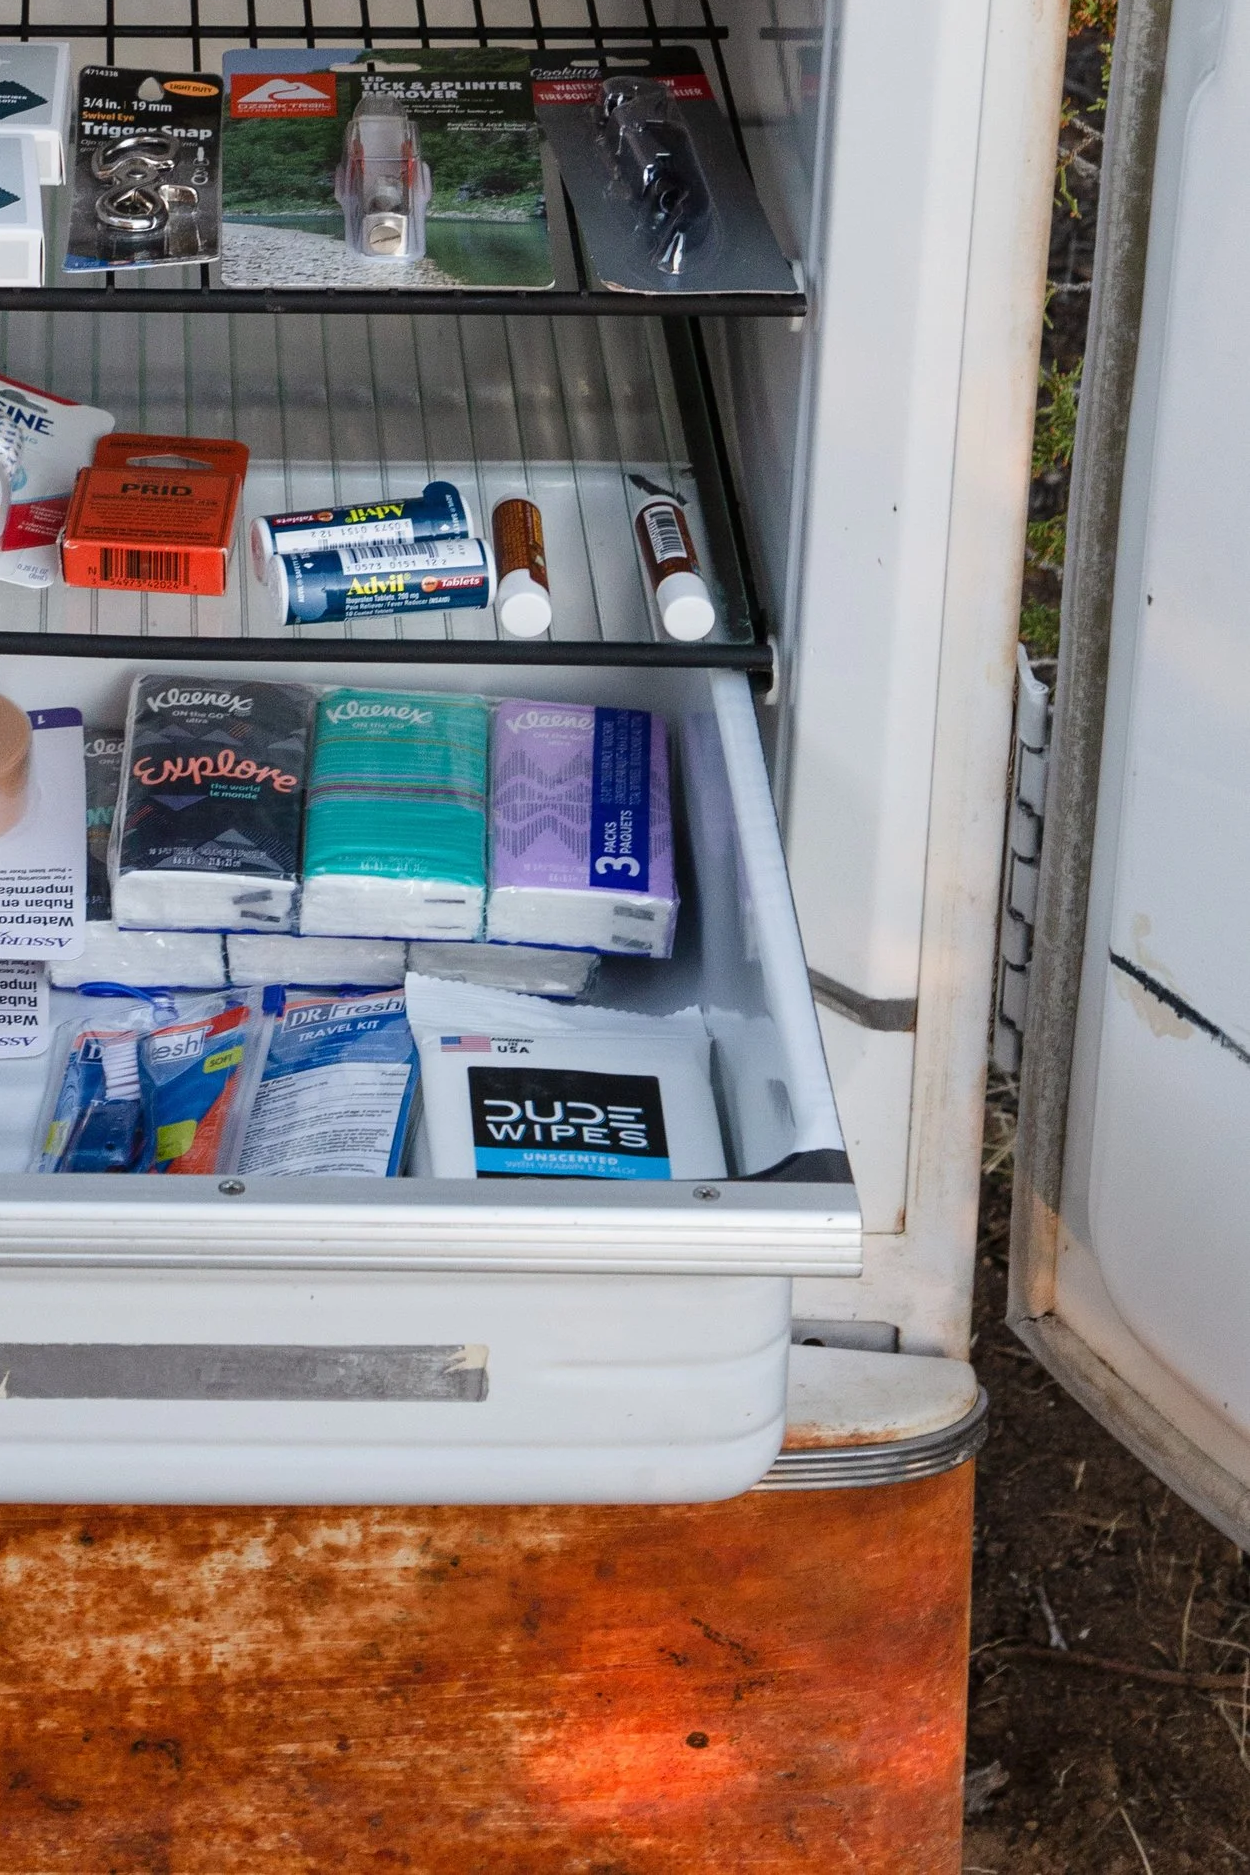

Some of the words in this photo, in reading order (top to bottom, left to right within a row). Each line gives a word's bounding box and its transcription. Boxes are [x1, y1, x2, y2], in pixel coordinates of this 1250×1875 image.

[530, 67, 600, 80] Cooking
[170, 83, 191, 92] LIGHT
[362, 81, 408, 91] TICK
[411, 81, 427, 91] &
[431, 81, 522, 91] SPLINTER
[83, 97, 103, 109] 3/4
[105, 99, 121, 110] in.
[132, 101, 146, 111] 19
[149, 103, 172, 112] mm
[82, 111, 115, 121] Swivel
[117, 113, 135, 122] Eye
[121, 483, 192, 496] PRID
[276, 514, 315, 524] Tablets
[350, 503, 406, 523] Advil
[347, 574, 405, 595] Advil
[441, 576, 480, 588] Tablets
[147, 688, 253, 712] Kleenex
[326, 701, 434, 725] Kleenex
[133, 749, 298, 794] Explore
[221, 791, 258, 800] monde
[229, 785, 261, 793] world
[604, 821, 616, 854] PACKS
[619, 810, 632, 854] PAQUETS
[595, 856, 640, 877] 3
[2, 899, 20, 907] en
[25, 899, 74, 909] Ruban
[290, 1006, 329, 1027] DR.
[330, 995, 405, 1019] Fresh
[299, 1022, 354, 1042] TRAVEL
[358, 1019, 380, 1031] KIT
[497, 1045, 530, 1054] USA
[209, 1054, 233, 1068] SOFT
[483, 1099, 647, 1129] DUDE
[487, 1124, 648, 1148] WIPES
[523, 1152, 619, 1166] UNSCENTED
